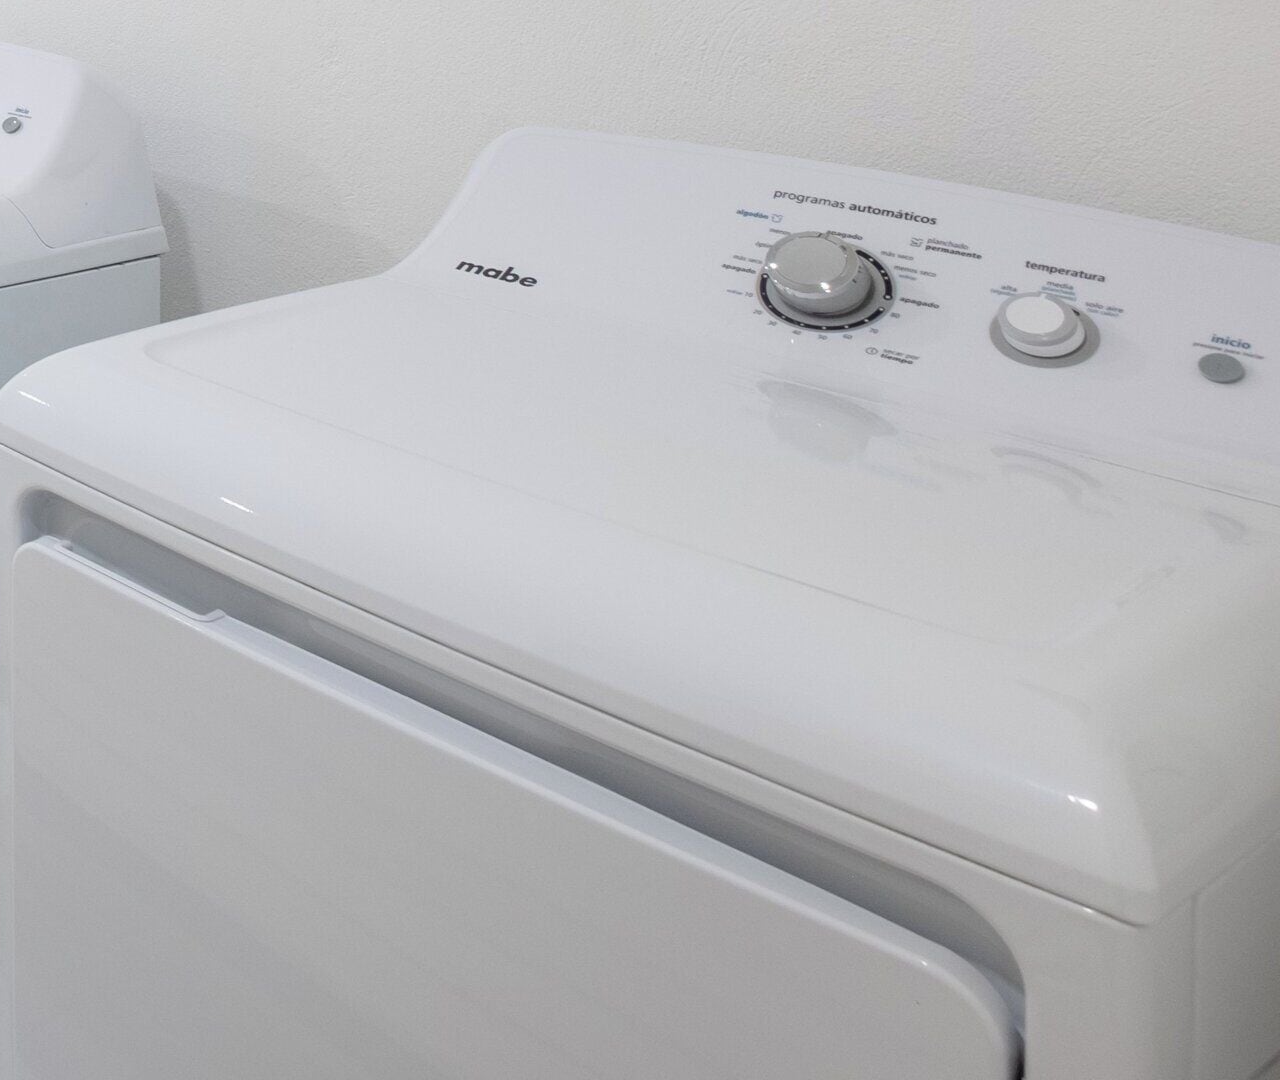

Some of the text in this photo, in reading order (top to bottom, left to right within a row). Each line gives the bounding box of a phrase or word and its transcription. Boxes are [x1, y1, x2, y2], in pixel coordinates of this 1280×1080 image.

[773, 189, 937, 225] programas automáticos
[736, 208, 769, 220] algodón
[826, 229, 863, 241] apagado
[926, 237, 969, 250] planchado
[925, 244, 982, 260] permanente
[455, 261, 538, 287] mabe
[721, 263, 757, 274] apagado
[894, 264, 918, 274] menos
[1025, 260, 1106, 283] temperatura
[1000, 284, 1018, 293] alta
[1046, 281, 1074, 291] media
[899, 296, 940, 309] apagado
[1210, 333, 1251, 350] inicio
[880, 353, 914, 365] tiempo
